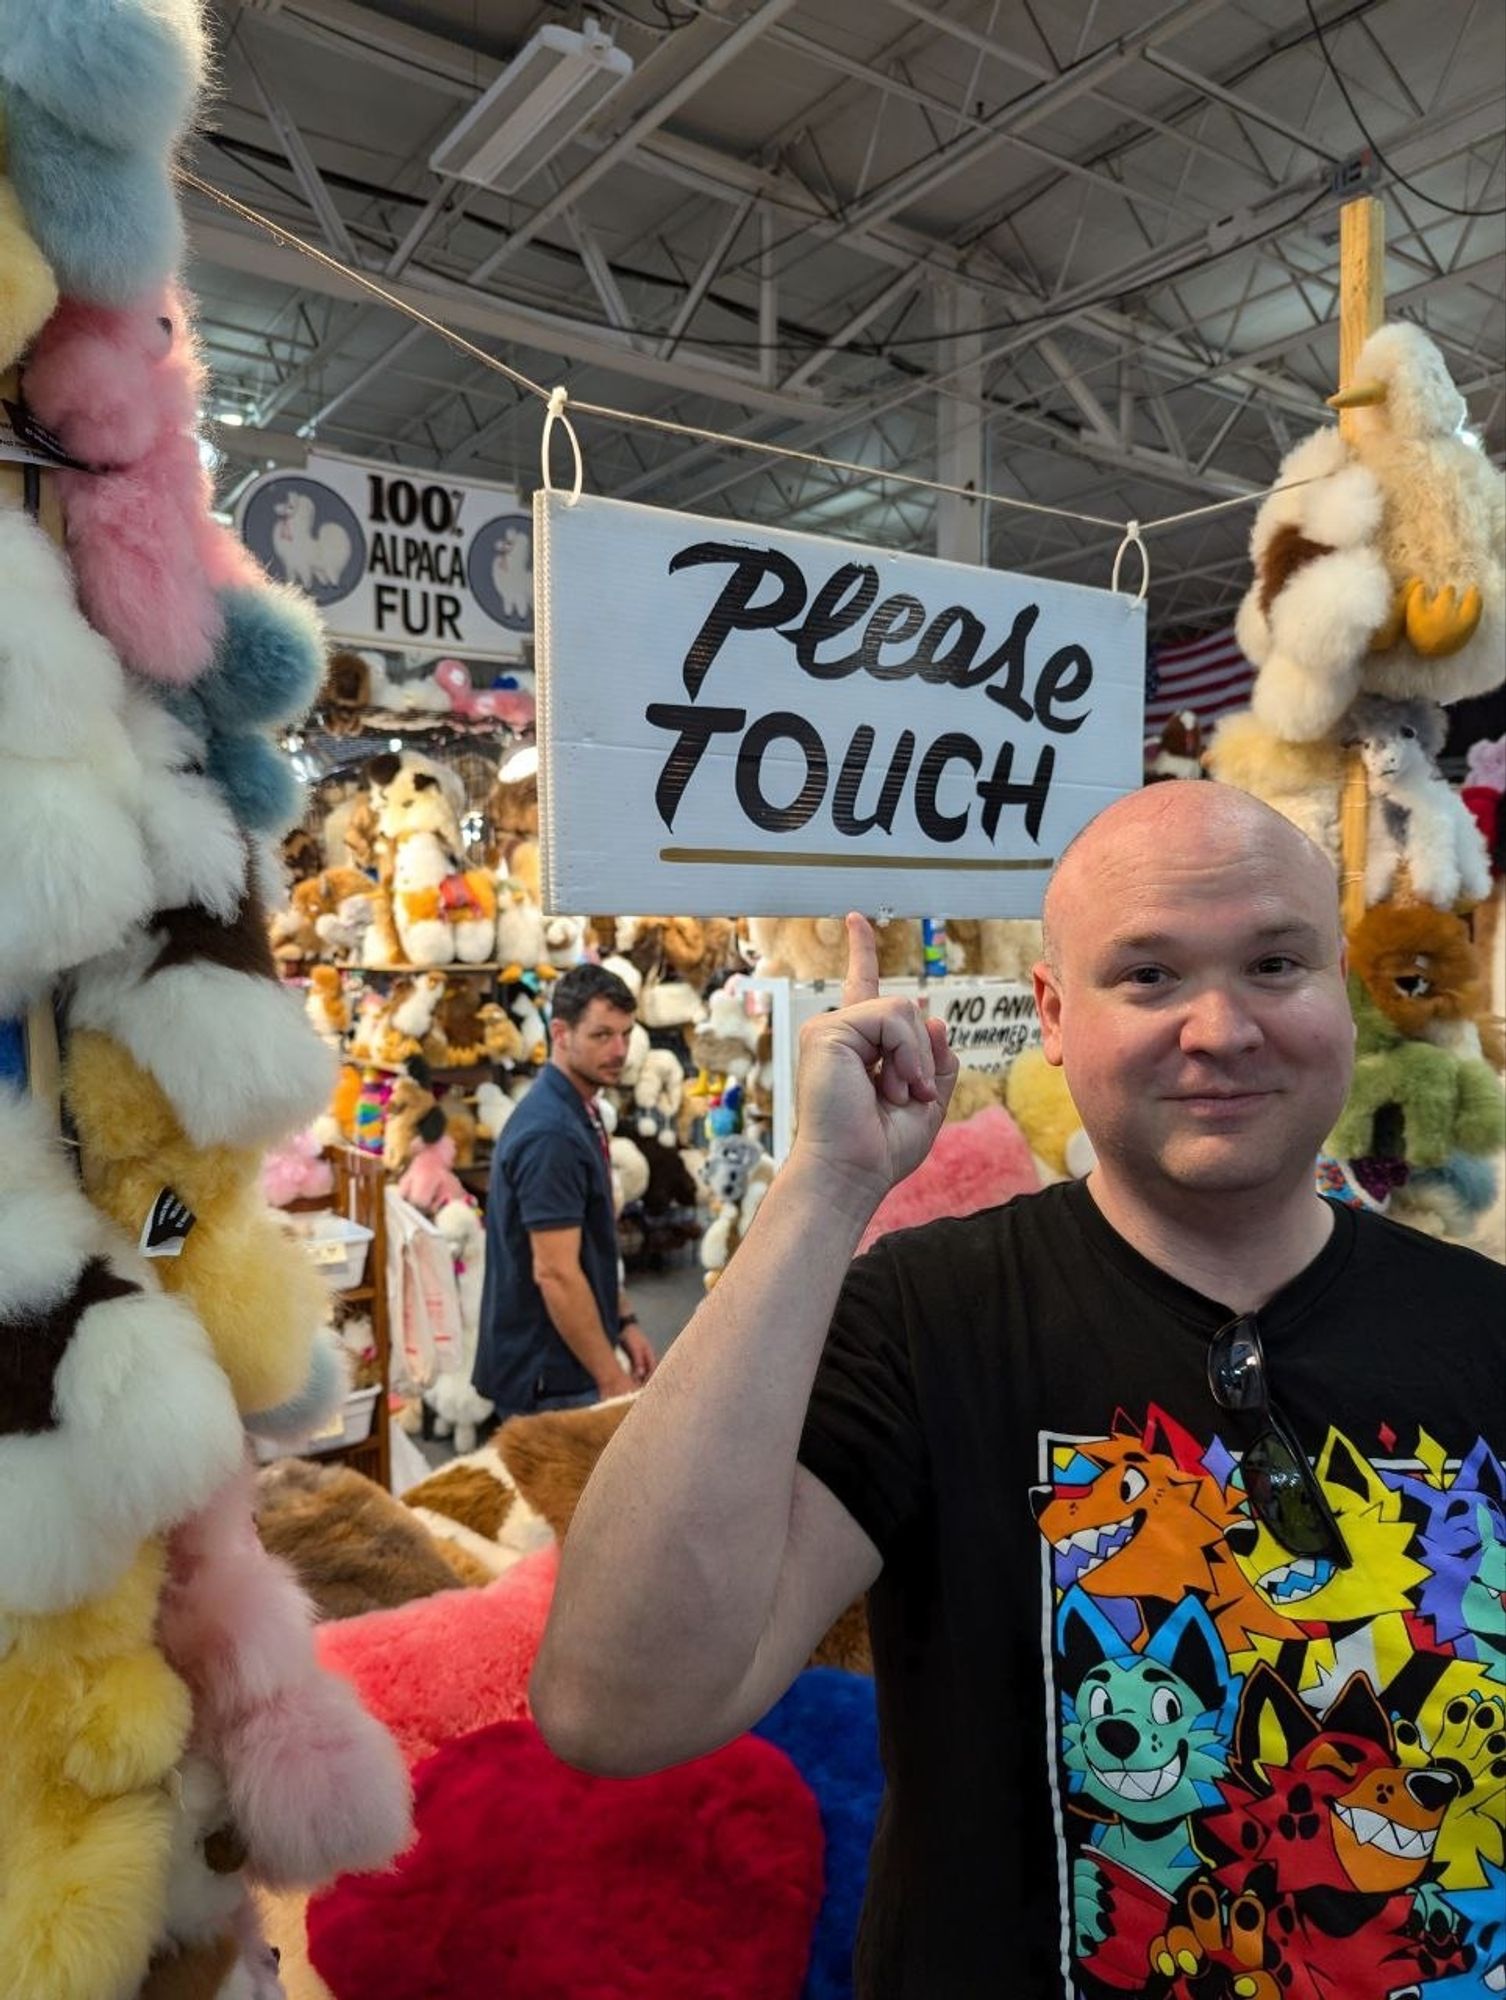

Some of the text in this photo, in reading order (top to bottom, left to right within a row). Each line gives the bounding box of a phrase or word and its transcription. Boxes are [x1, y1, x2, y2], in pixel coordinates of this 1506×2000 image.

[367, 474, 466, 538] 100%
[368, 532, 466, 588] ALPACA
[375, 583, 463, 641] FUR
[669, 540, 1093, 734] Please
[645, 703, 1056, 845] TOUCH
[947, 996, 985, 1023] NO
